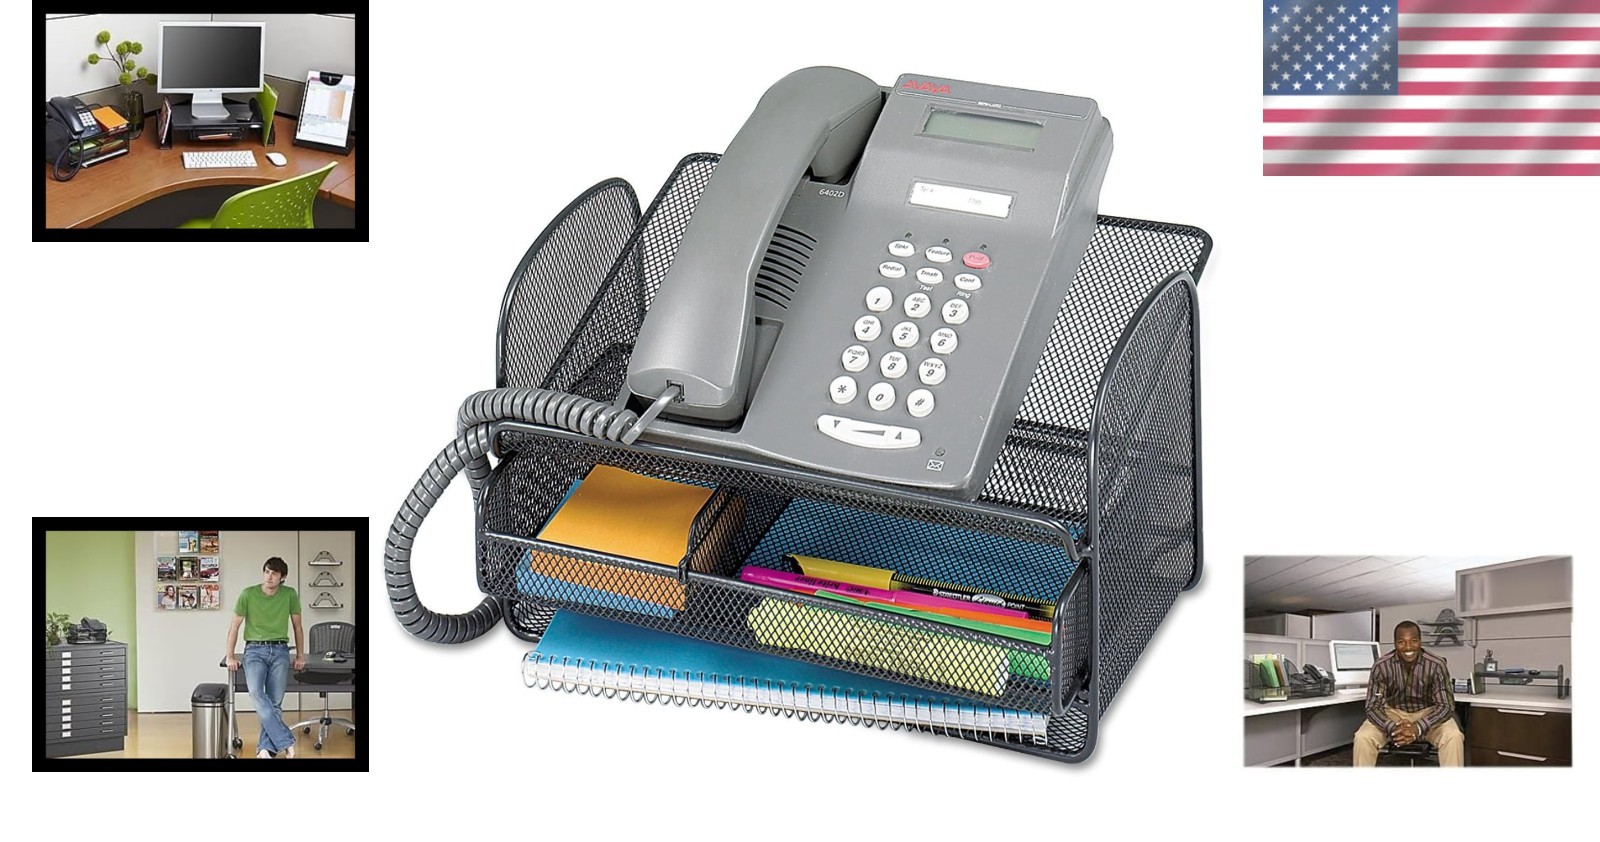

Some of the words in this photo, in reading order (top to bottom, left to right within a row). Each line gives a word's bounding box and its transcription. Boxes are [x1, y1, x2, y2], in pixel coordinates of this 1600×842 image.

[902, 79, 952, 95] AVAYA
[819, 188, 845, 198] 6402D
[927, 248, 950, 256] Feature
[882, 264, 902, 272] Redial
[874, 297, 881, 305] 1
[862, 326, 870, 334] 4
[899, 332, 908, 340] 5
[926, 369, 934, 377] 9
[794, 576, 816, 586] liner
[1006, 602, 1026, 610] POINT
